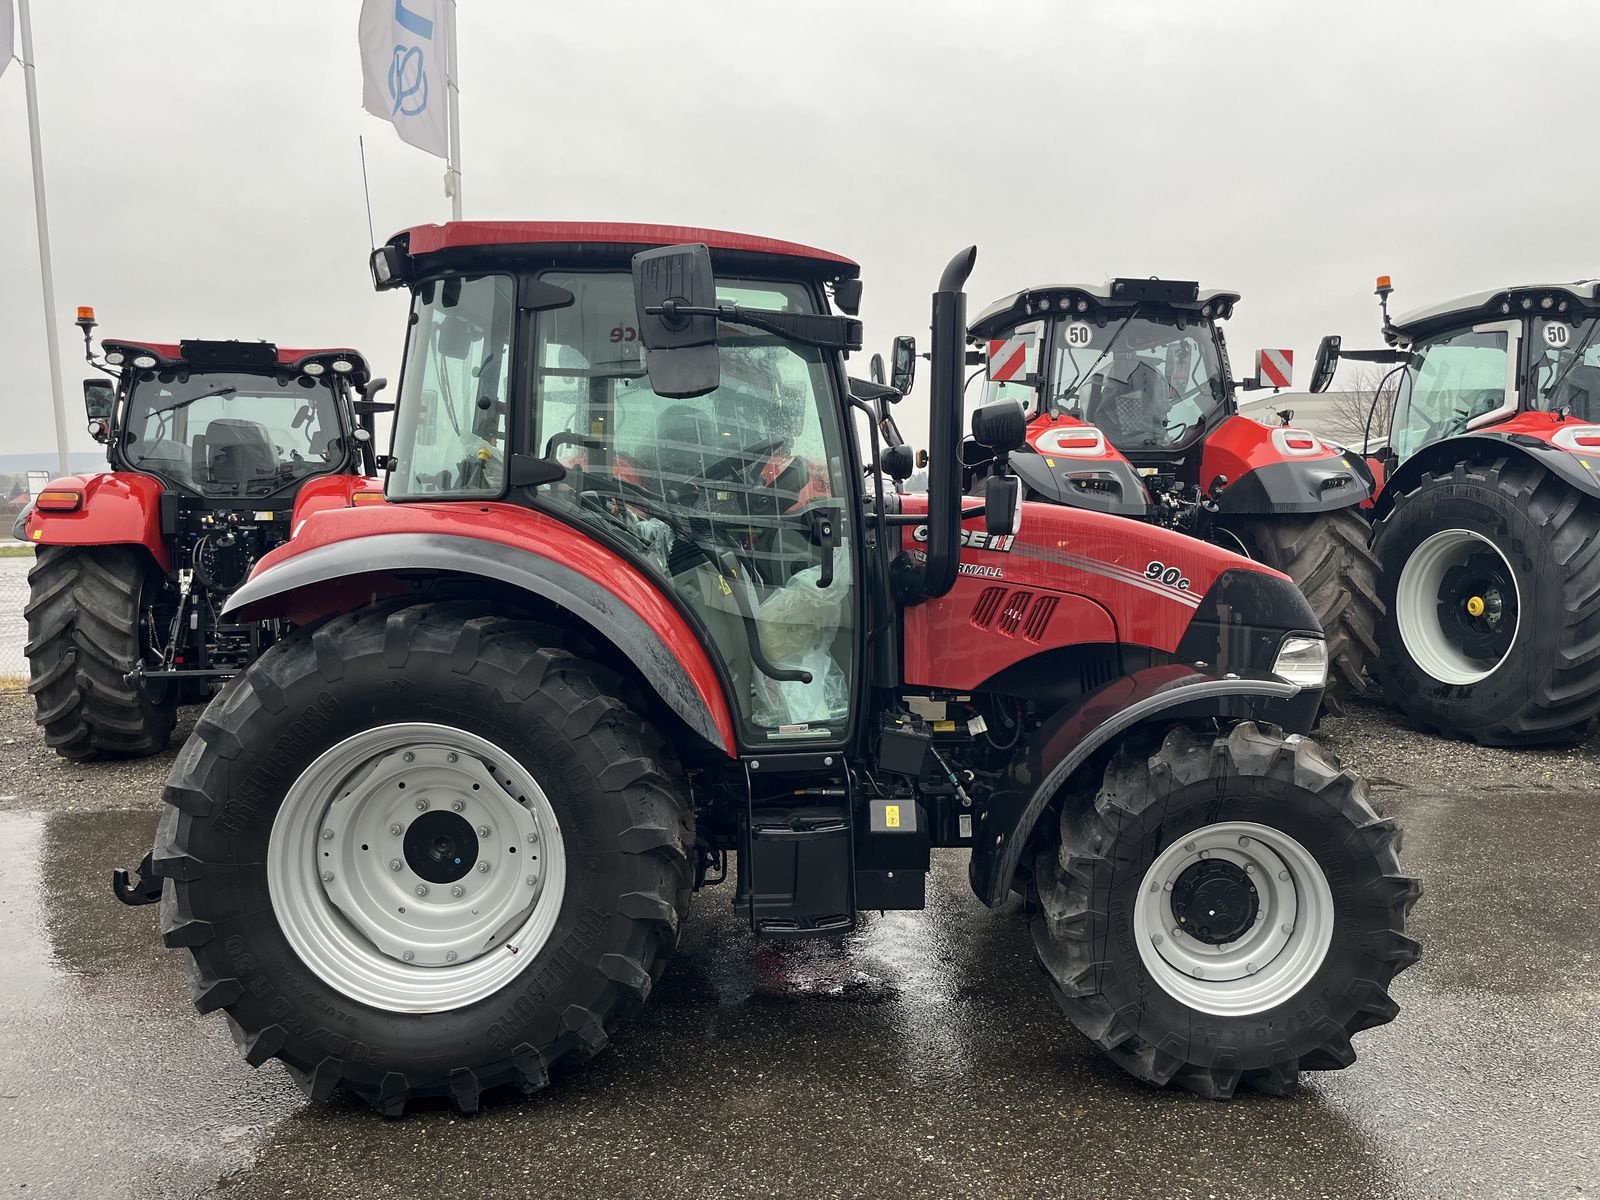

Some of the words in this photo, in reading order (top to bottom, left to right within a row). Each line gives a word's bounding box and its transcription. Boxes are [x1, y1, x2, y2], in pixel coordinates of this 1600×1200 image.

[1070, 326, 1089, 343] 50
[1547, 326, 1567, 343] 50
[913, 524, 988, 548] CSE
[958, 562, 1004, 578] RMALL
